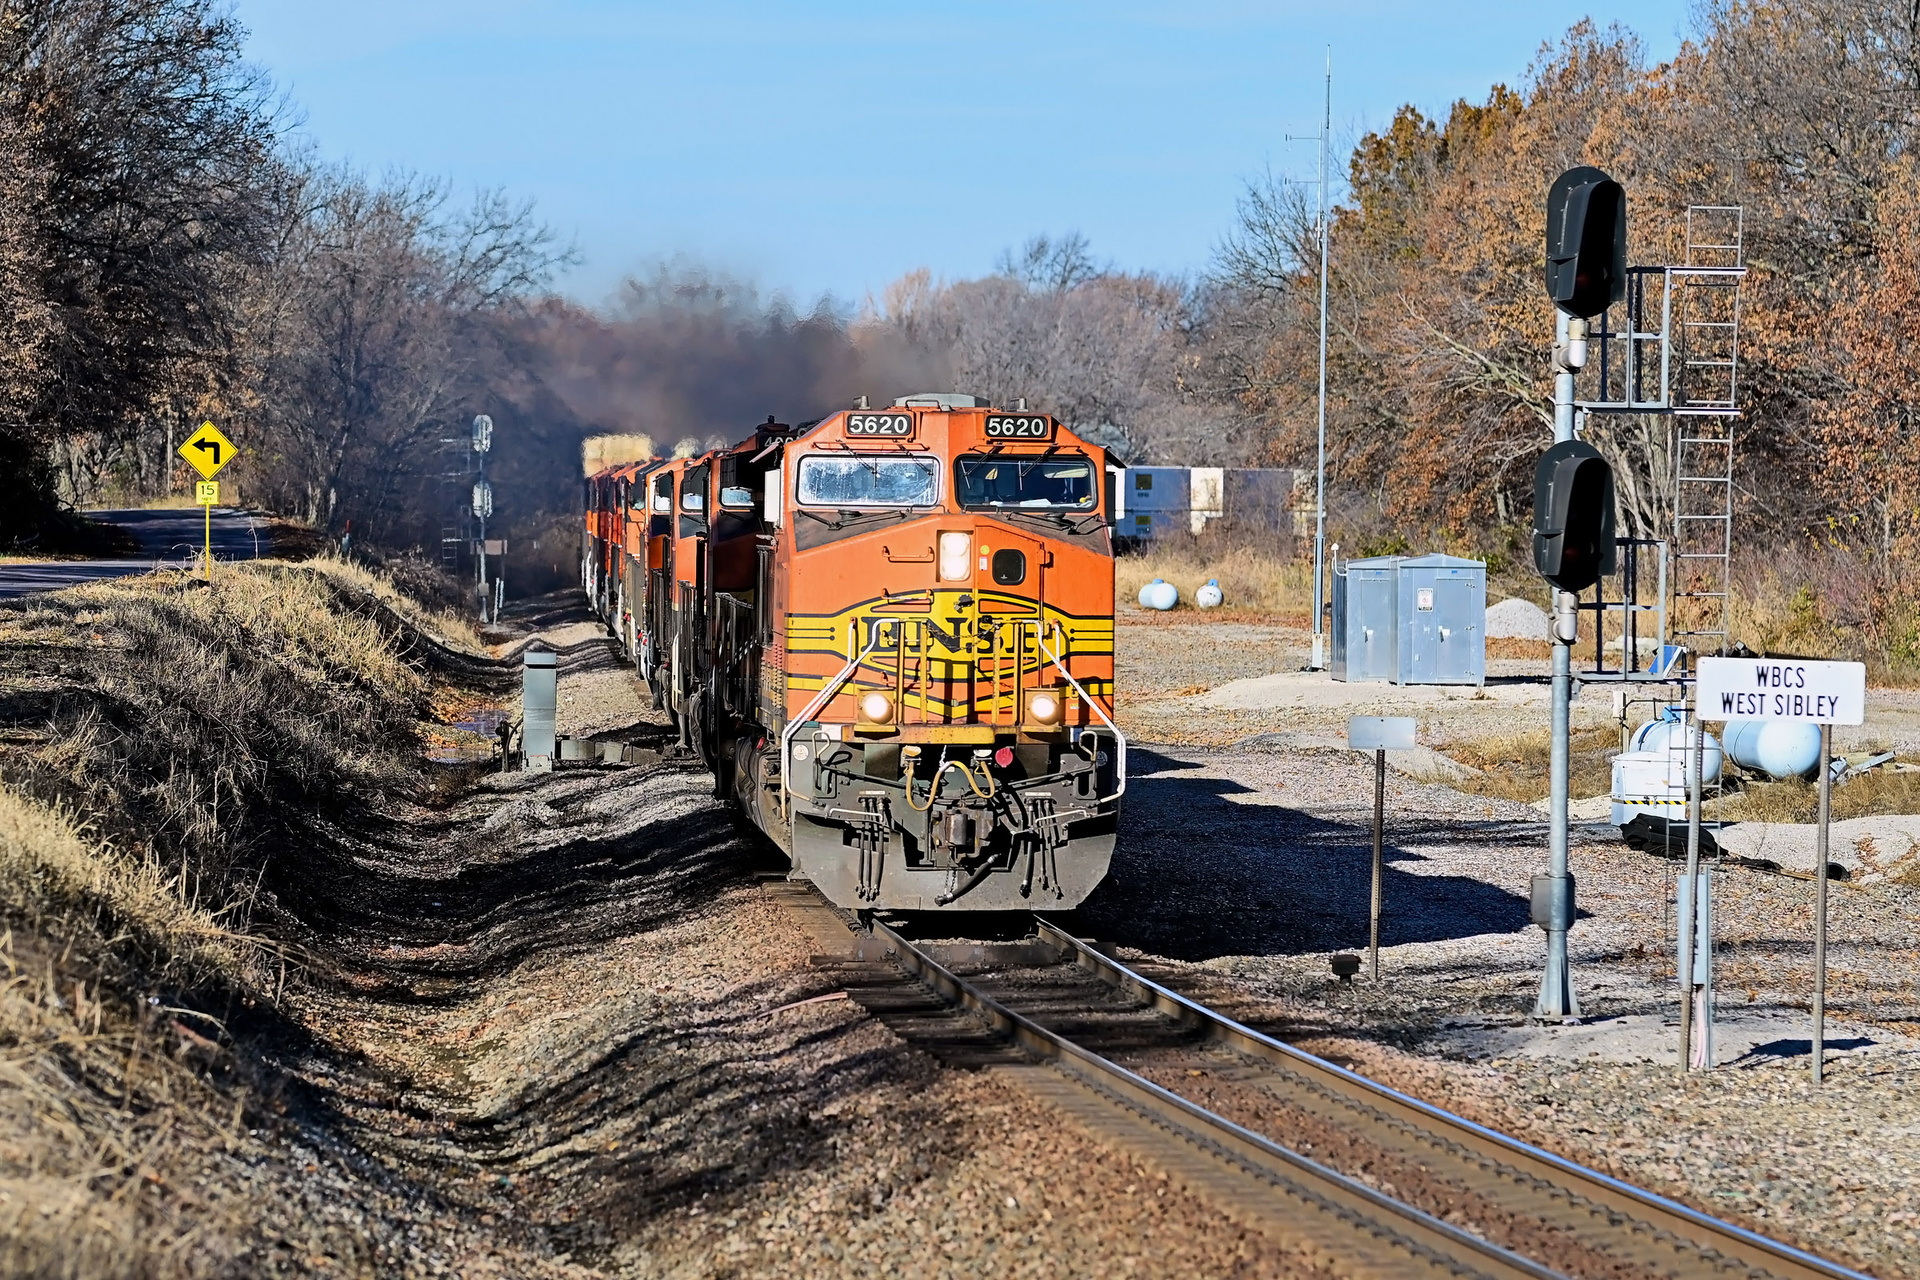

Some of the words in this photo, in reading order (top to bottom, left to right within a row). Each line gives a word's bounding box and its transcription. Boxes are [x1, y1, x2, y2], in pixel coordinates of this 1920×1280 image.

[850, 416, 908, 434] 5620
[988, 417, 1044, 436] 5620
[201, 485, 215, 495] 15
[1756, 665, 1805, 688] WBCS
[1721, 692, 1766, 715] WEST
[1774, 694, 1839, 717] SIBLEY
